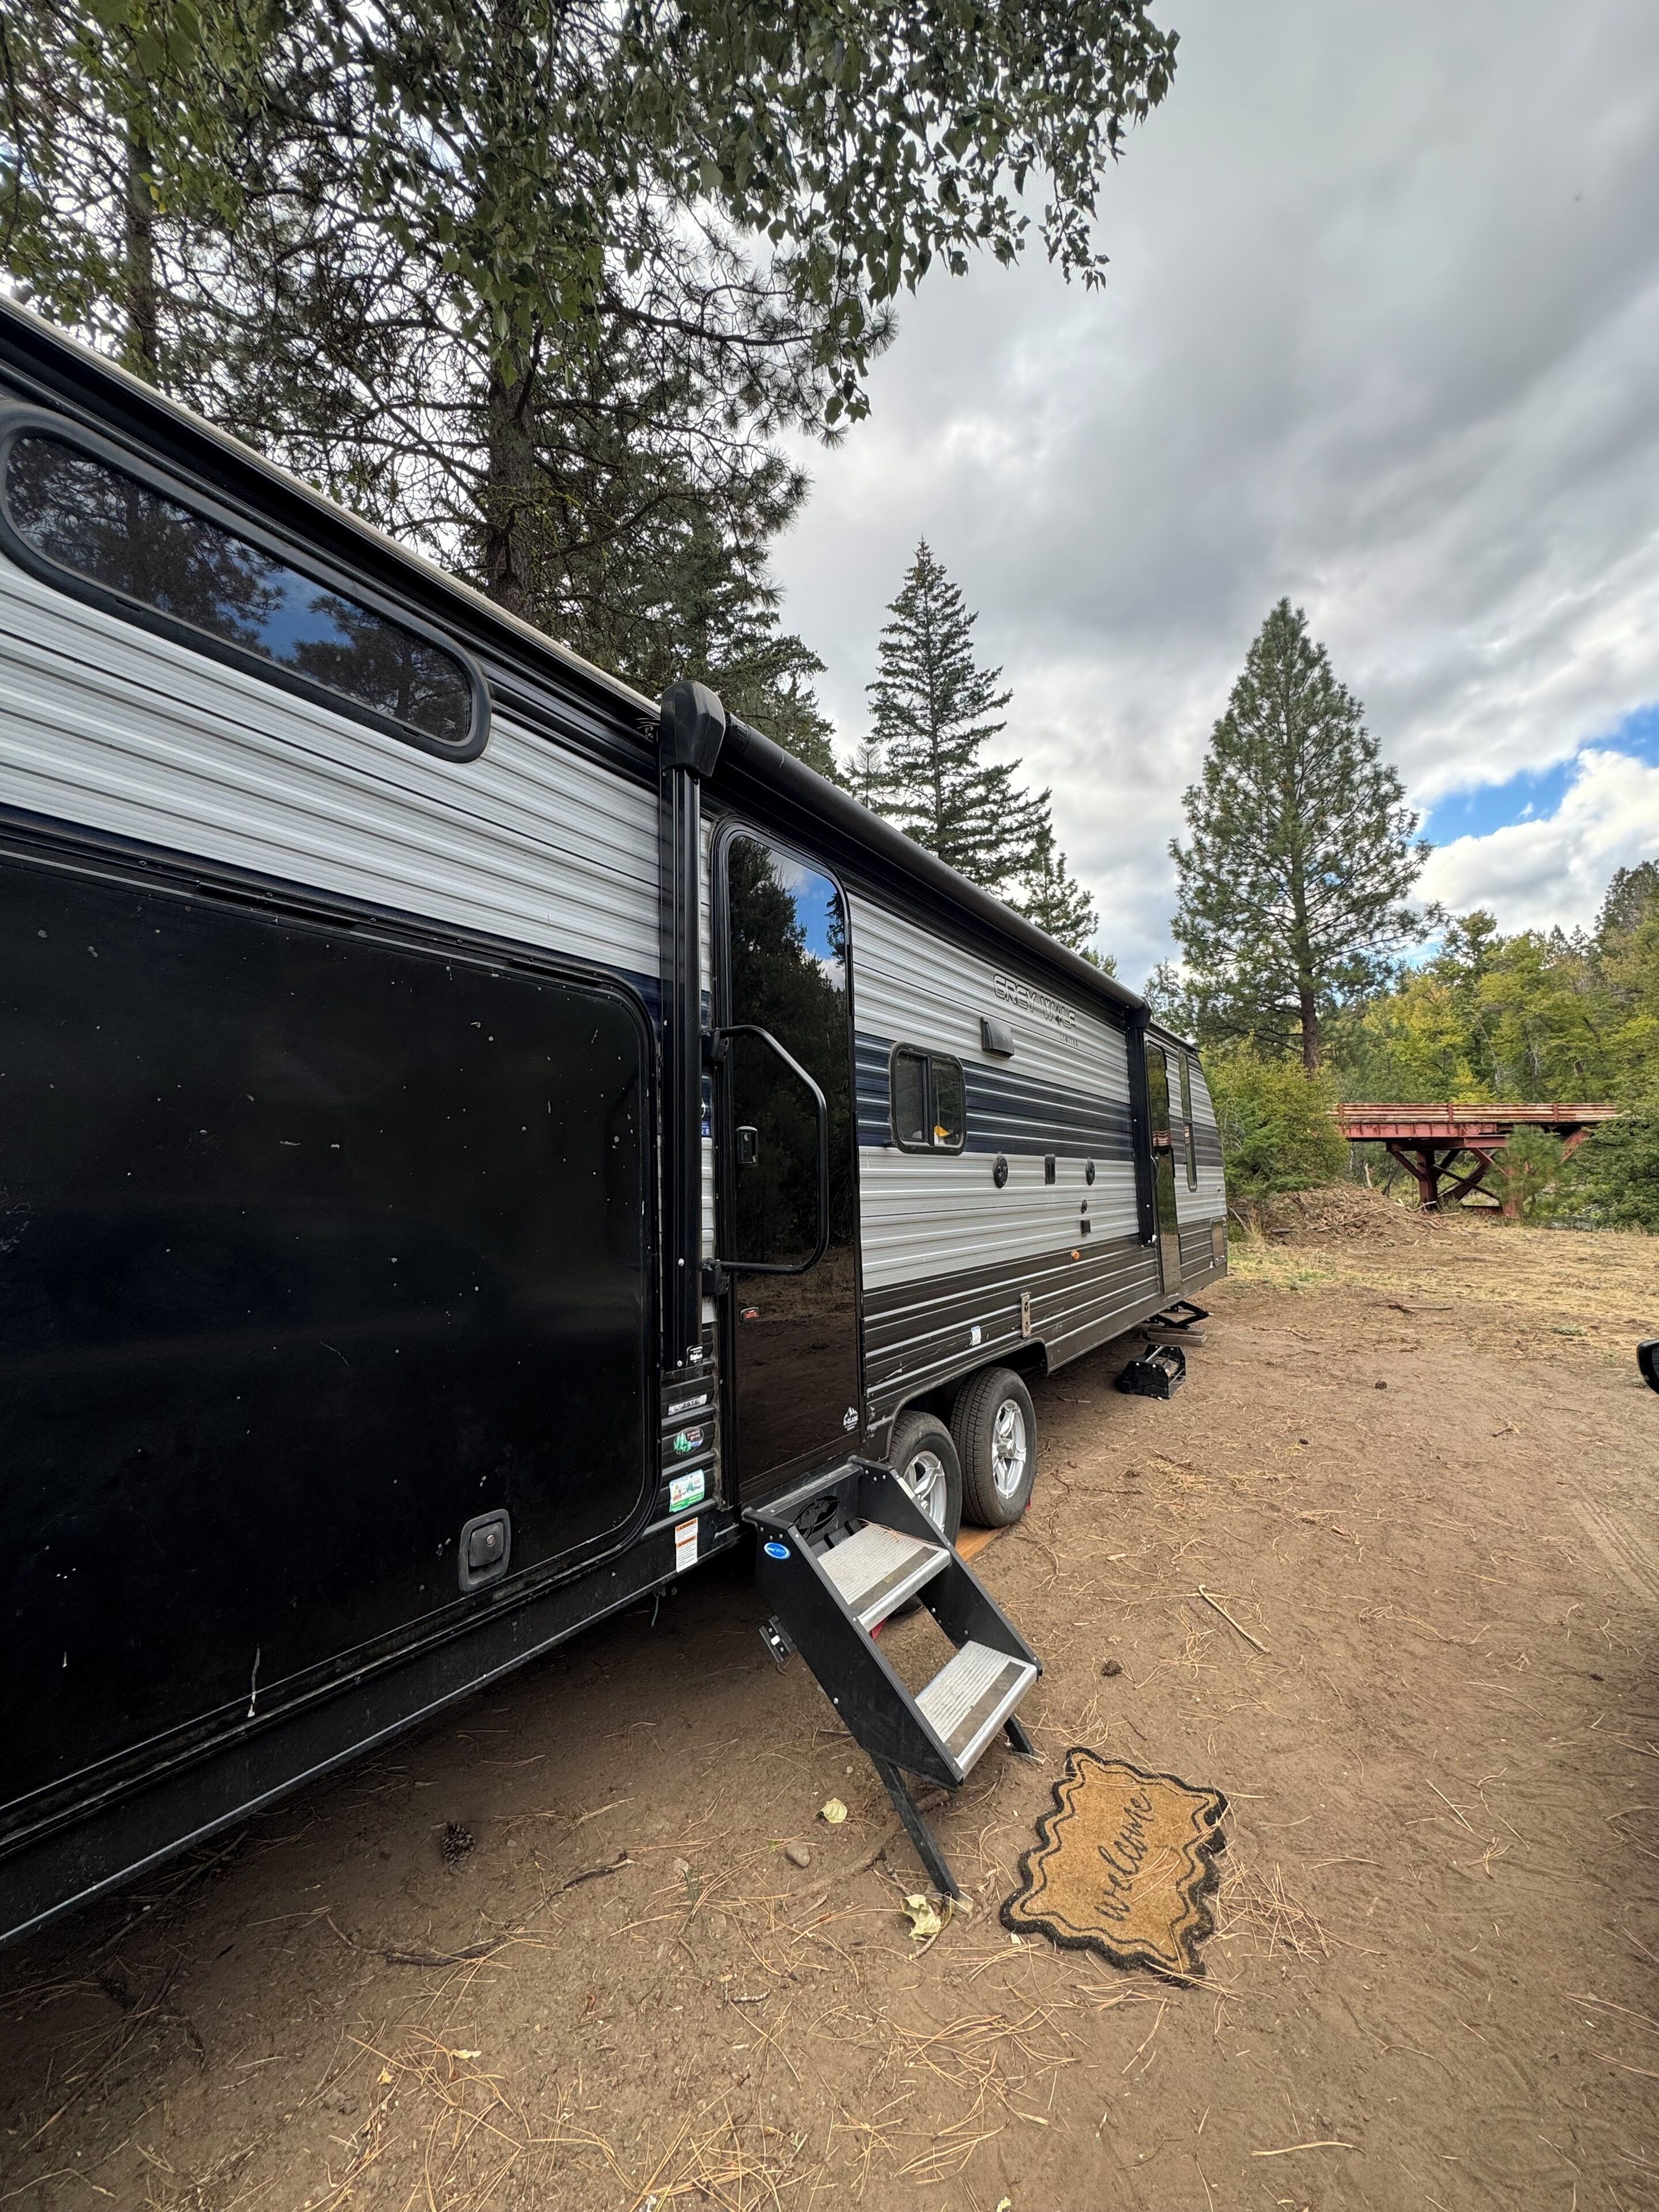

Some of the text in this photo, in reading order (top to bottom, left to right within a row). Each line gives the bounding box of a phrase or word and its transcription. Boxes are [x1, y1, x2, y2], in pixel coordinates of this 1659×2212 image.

[994, 974, 1076, 1029] GREY WOLF
[1094, 1788, 1154, 1921] welcome
